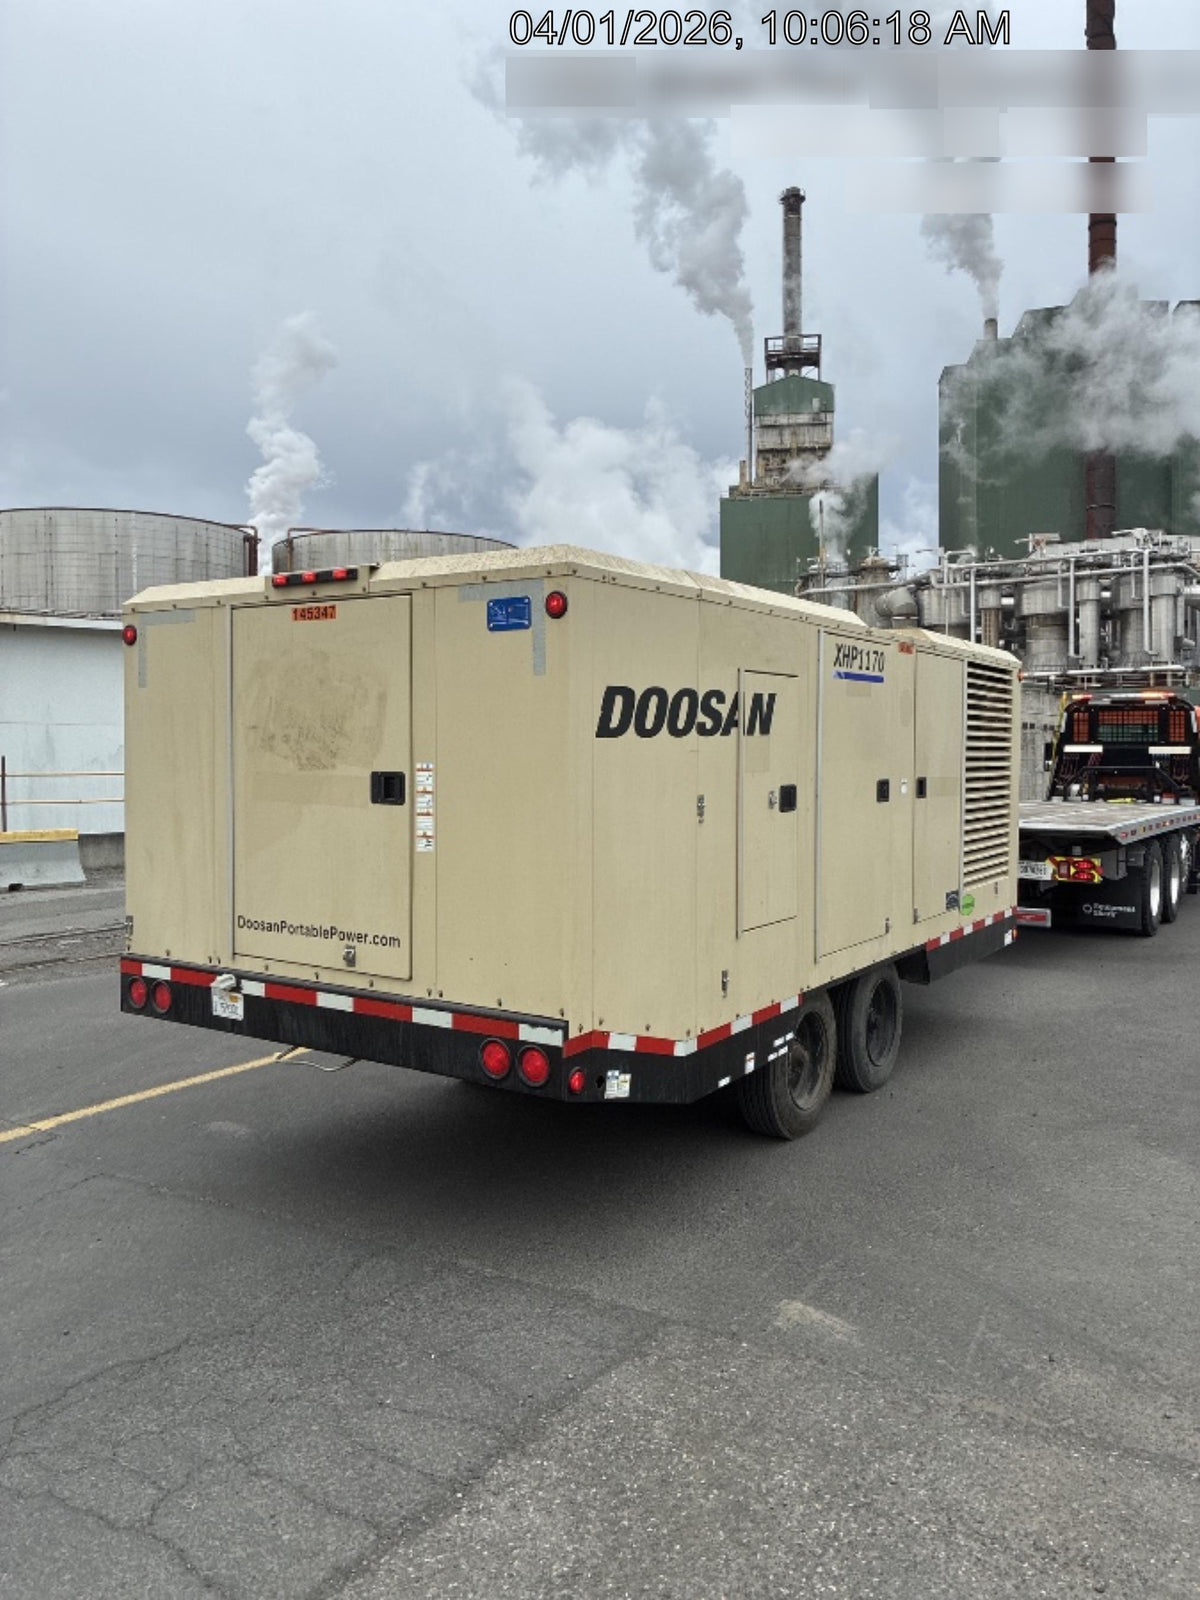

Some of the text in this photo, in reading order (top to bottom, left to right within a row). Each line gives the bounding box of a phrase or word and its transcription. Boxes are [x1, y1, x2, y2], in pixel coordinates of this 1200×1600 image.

[292, 605, 336, 621] 145347
[833, 643, 886, 673] XHP1170
[595, 685, 777, 738] DOOSAN
[237, 915, 401, 948] DoosanPortablePower.com
